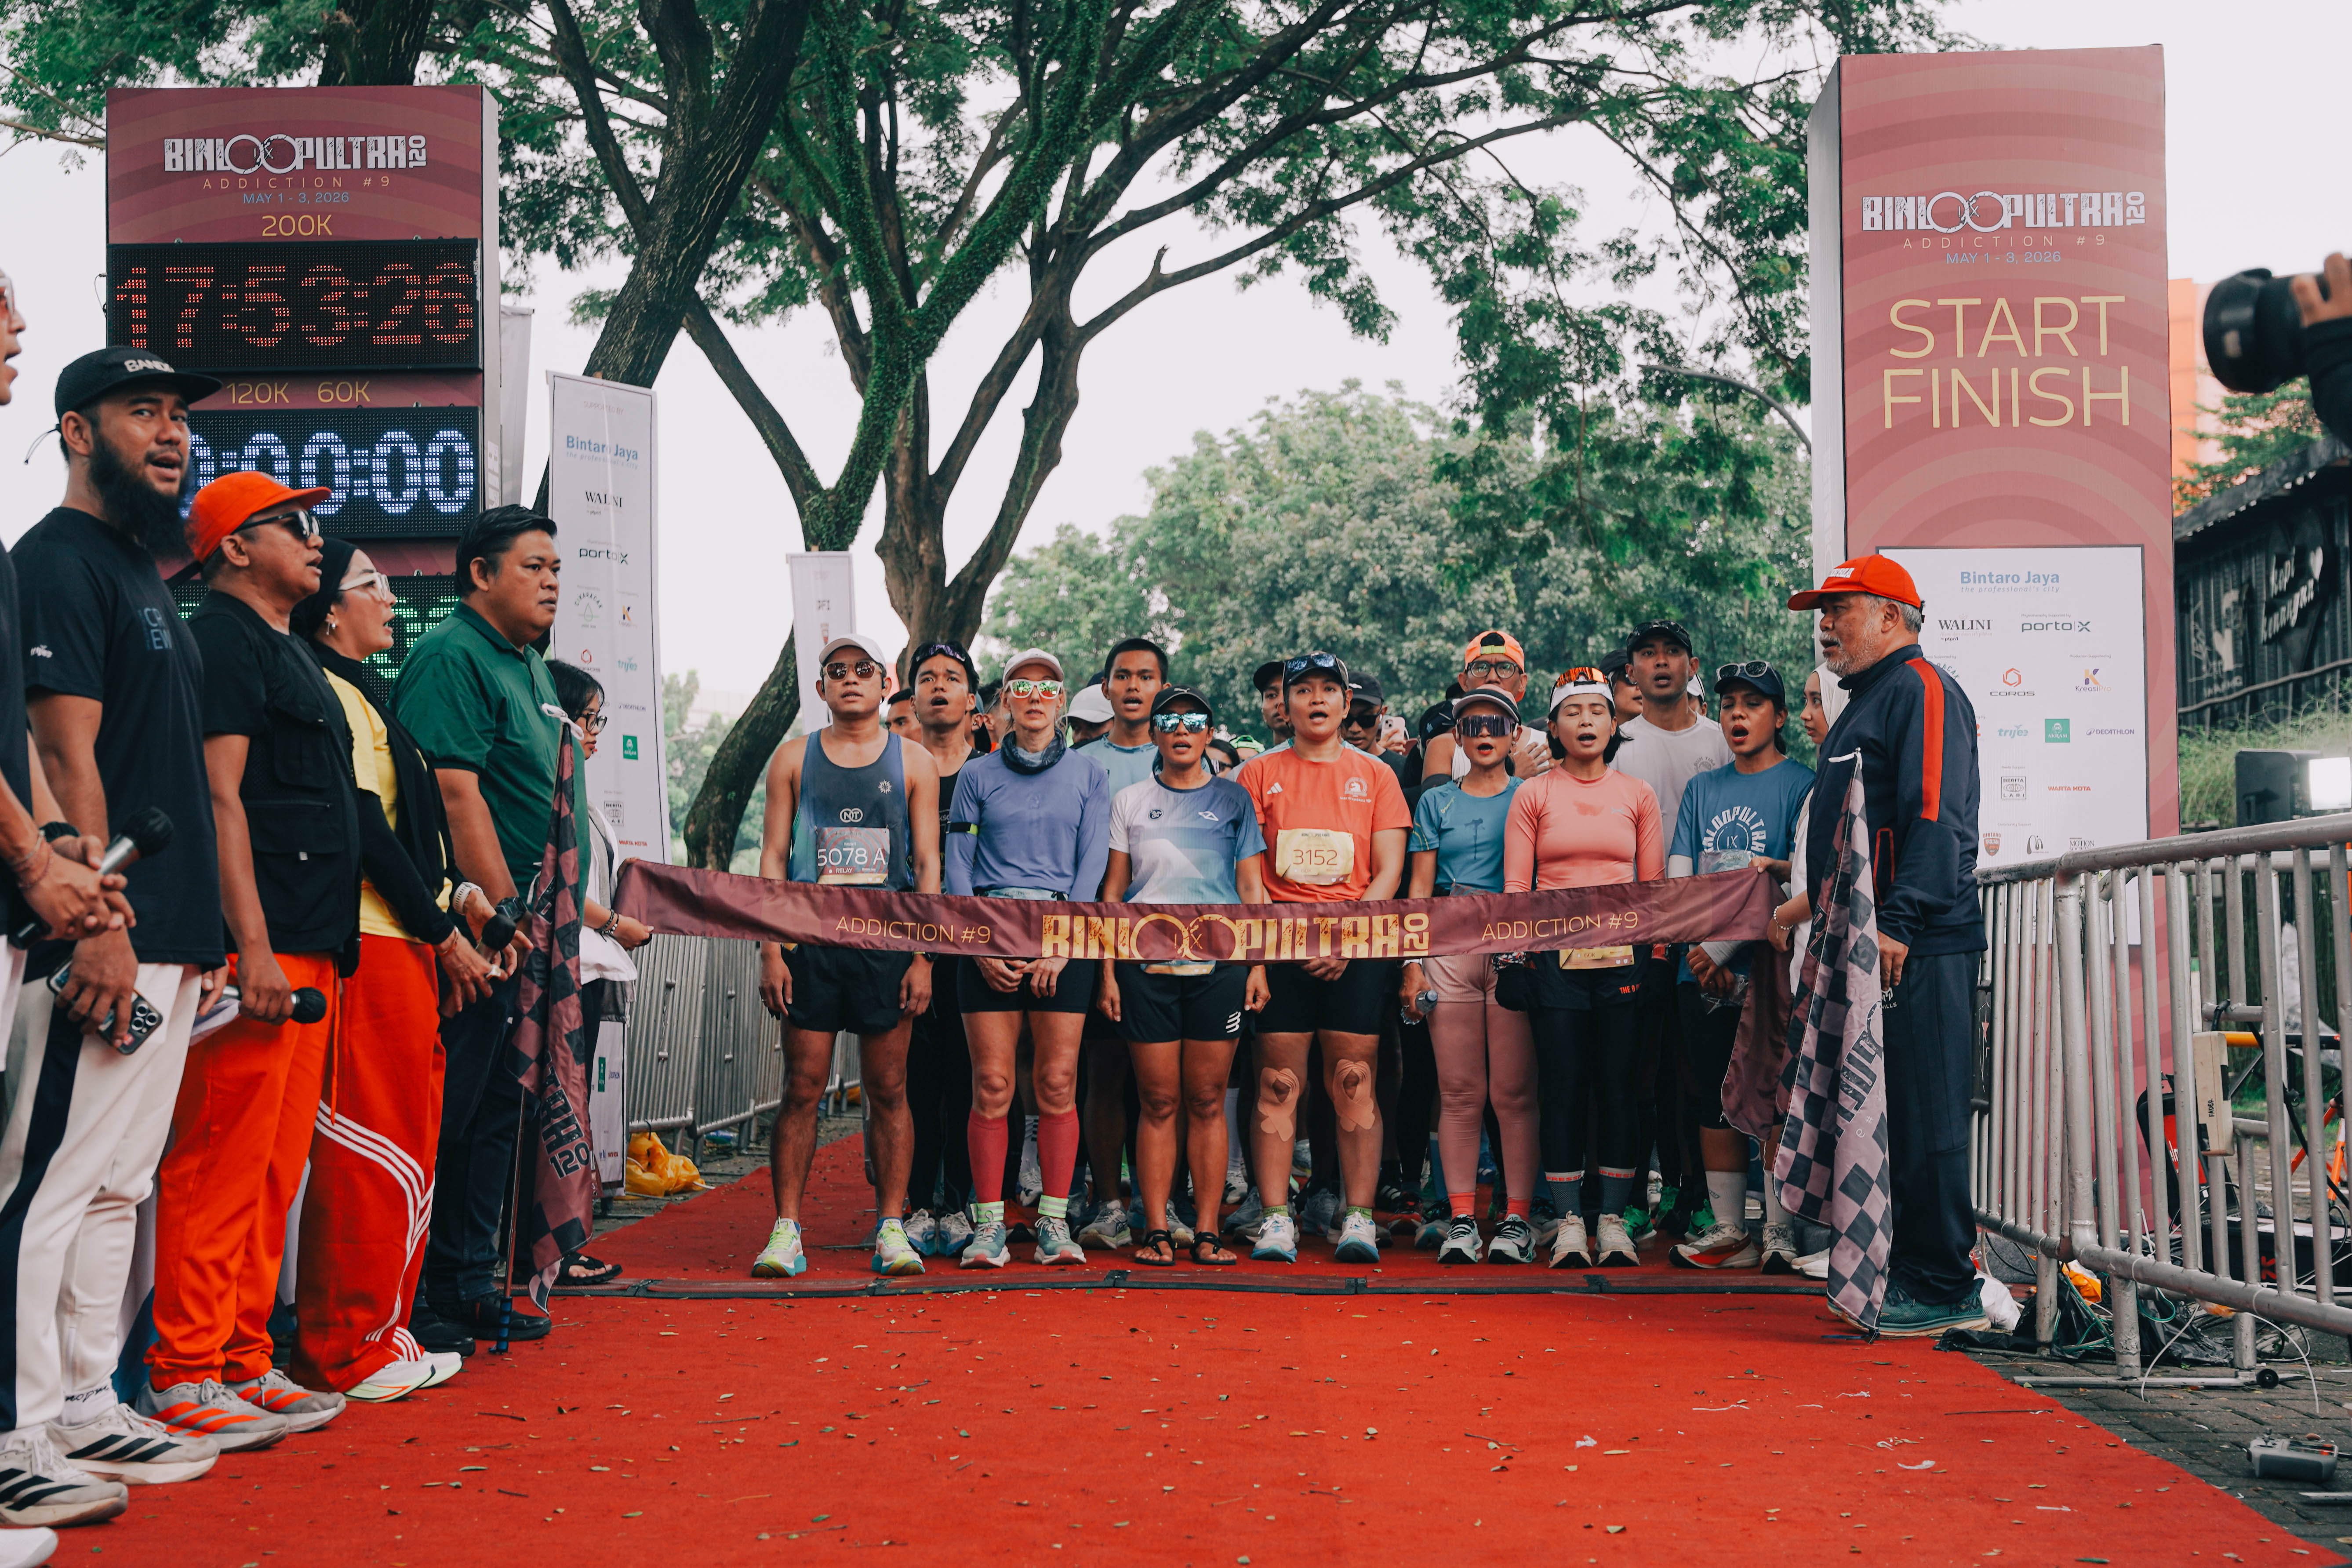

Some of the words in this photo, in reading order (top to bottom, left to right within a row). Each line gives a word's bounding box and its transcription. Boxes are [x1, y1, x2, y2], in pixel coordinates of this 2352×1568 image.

[408, 135, 426, 168] 120
[203, 177, 342, 189] ADDICTION
[243, 193, 273, 204] MAY
[315, 192, 349, 204] 2026
[2126, 191, 2146, 226] 120
[262, 214, 333, 237] 200K
[1903, 236, 2054, 249] ADDICTION
[1946, 253, 1978, 265] MAY
[2025, 251, 2061, 263] 2026
[116, 262, 473, 348] 17:53:26
[1890, 295, 2125, 359] START
[227, 382, 289, 404] 120K
[317, 381, 371, 403] 60K
[1884, 366, 2130, 429] FINISH
[567, 435, 611, 453] Bintaro
[614, 444, 638, 461] Jaya
[1960, 571, 2020, 584] Bintaro
[2025, 571, 2060, 586] Jaya
[1938, 619, 1991, 630] WALINI
[818, 848, 868, 866] 5078
[873, 848, 886, 866] A
[1293, 849, 1337, 866] 3152
[836, 916, 954, 943] ADDICTION
[961, 925, 991, 944] #9
[1481, 913, 1601, 942] ADDICTION
[1608, 911, 1639, 931] #9
[549, 1142, 590, 1180] 120
